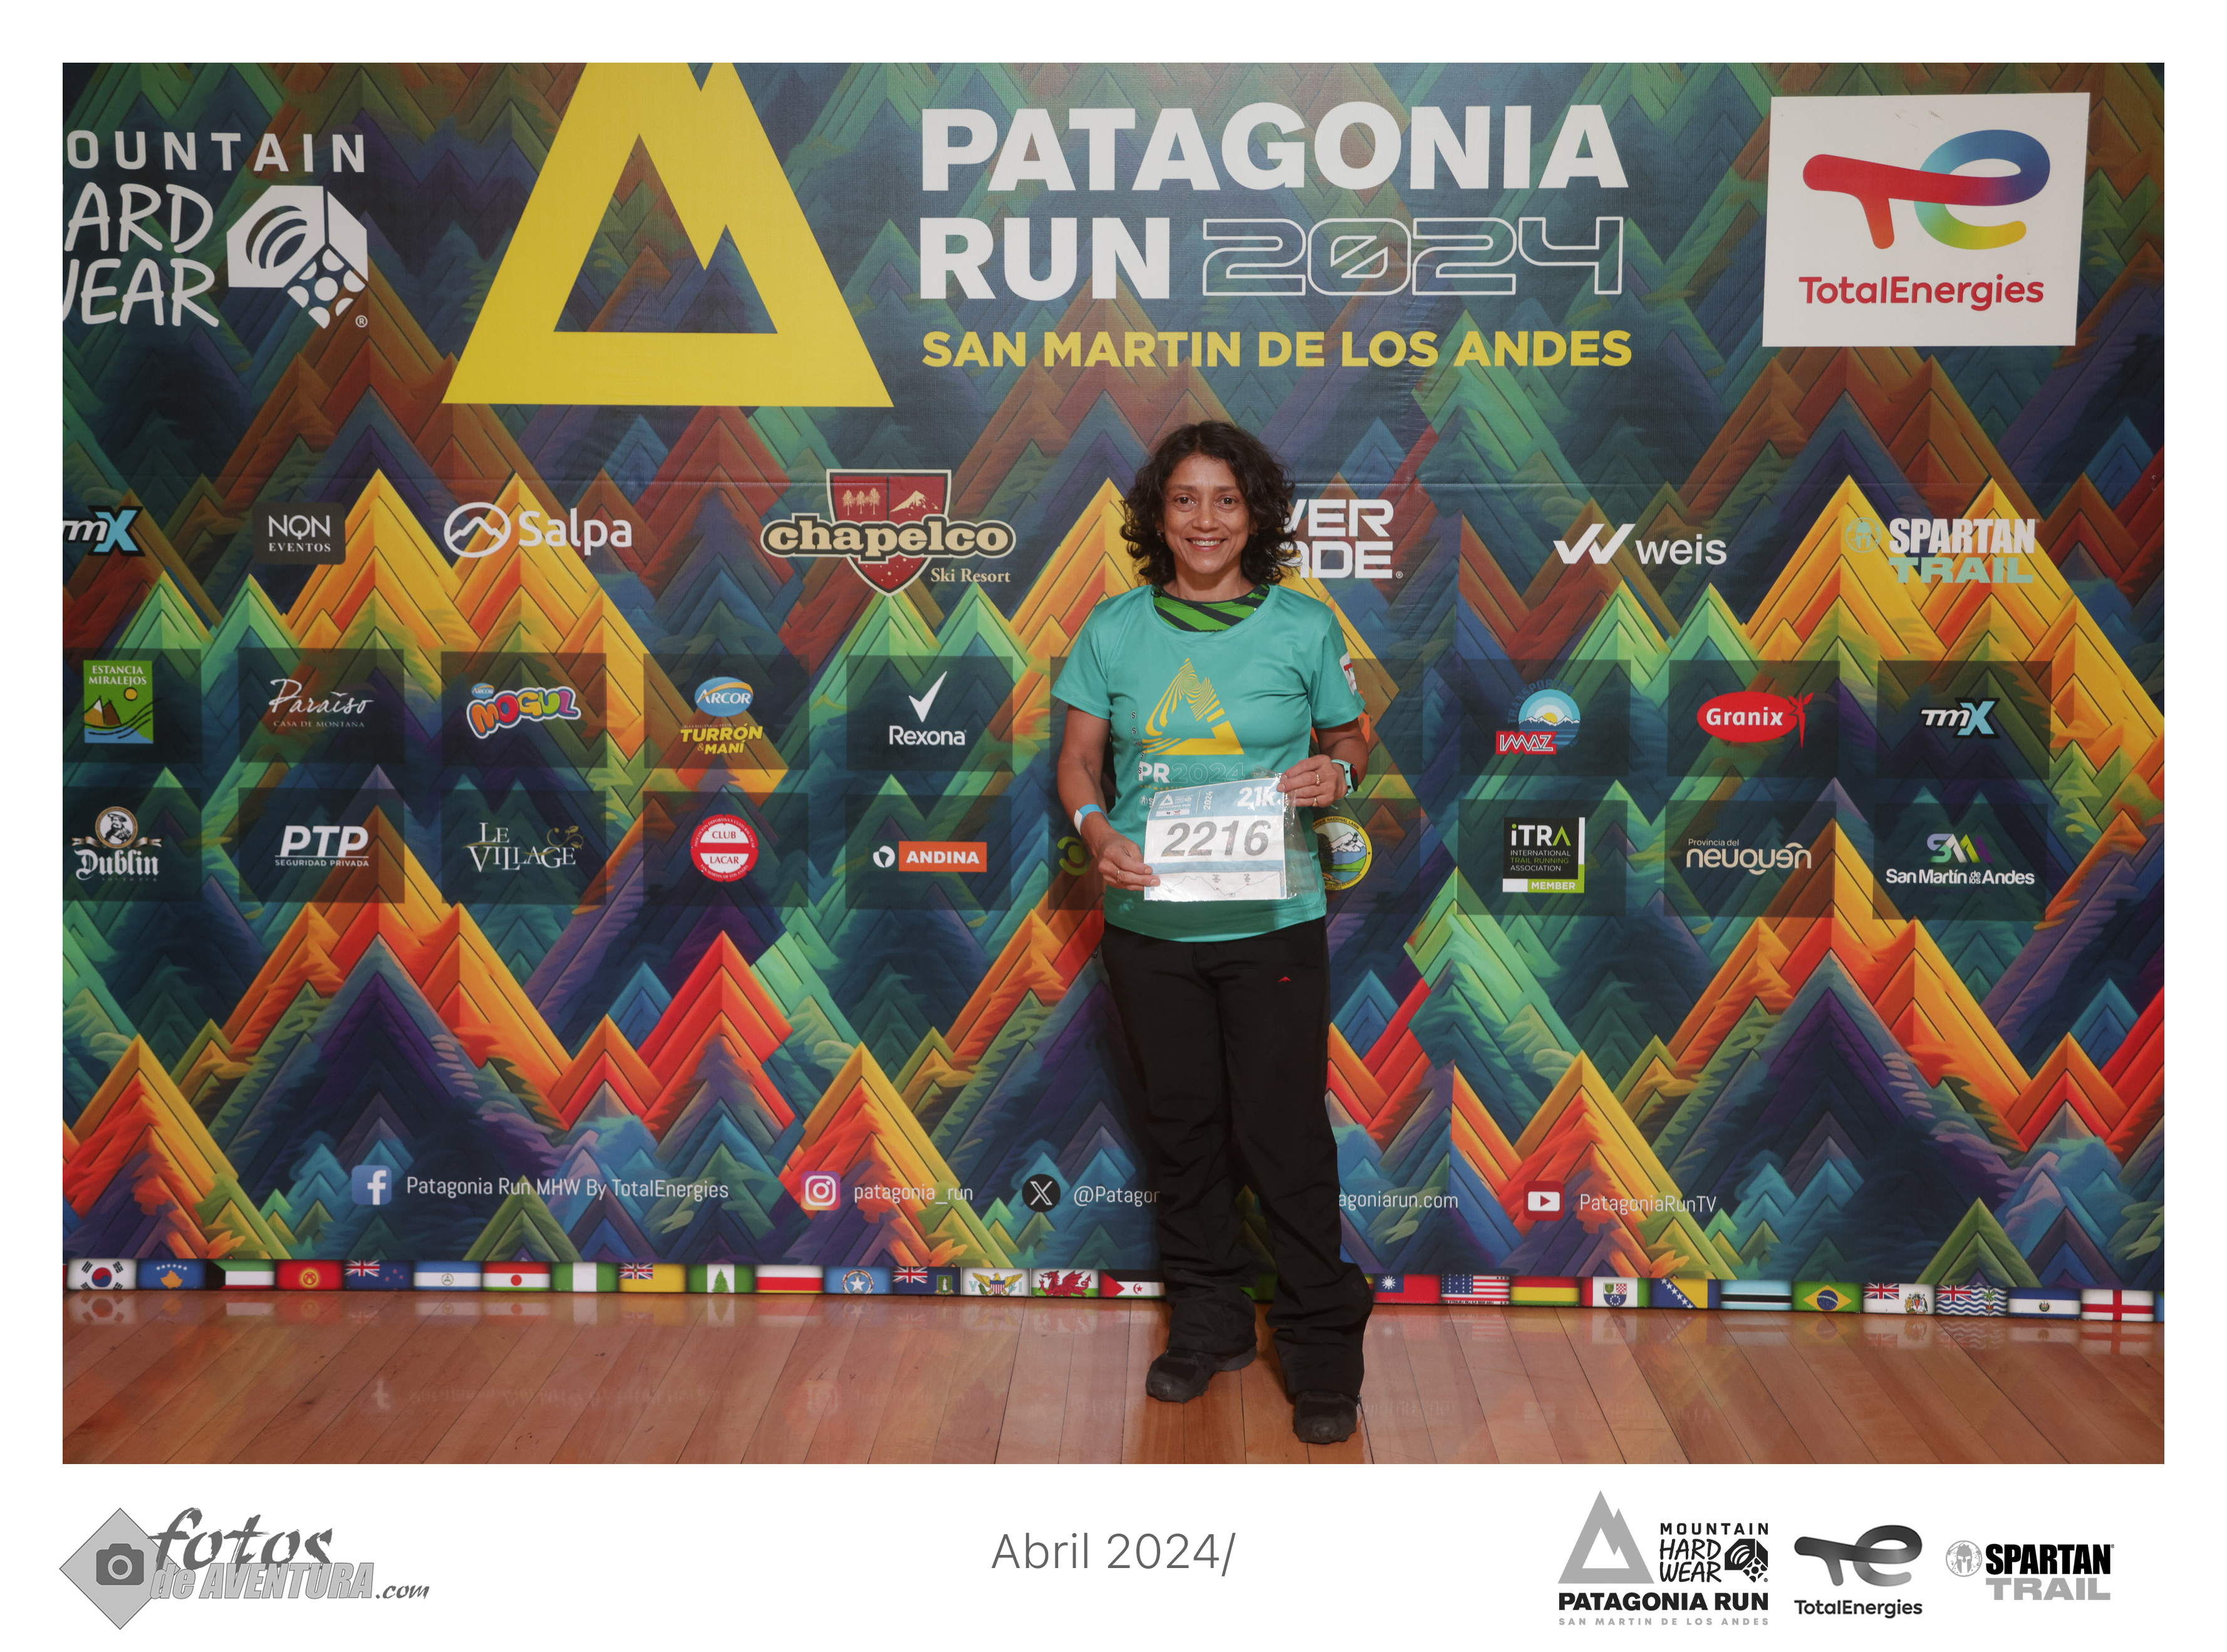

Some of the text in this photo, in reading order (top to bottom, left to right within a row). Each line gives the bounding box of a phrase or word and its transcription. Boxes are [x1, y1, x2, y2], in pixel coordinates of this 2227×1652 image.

[67, 130, 365, 173] OUNTAIN
[920, 101, 1629, 192] PATAGONIA
[63, 182, 214, 253] ARD
[919, 216, 1624, 301] RUN 2024
[1799, 274, 2044, 311] TotalEnergies
[922, 330, 1633, 368] SAN MARTIN DE LOS ANDES
[268, 515, 331, 541] NQN
[518, 507, 632, 556] Salpa
[766, 515, 1013, 559] chapelco
[1889, 517, 2035, 554] SPARTAN
[268, 542, 332, 553] EVENTOS
[1636, 533, 1727, 566] weis
[931, 568, 1011, 583] Ski Resort
[1888, 557, 2033, 584] TRAIL
[92, 665, 144, 675] ESTANCIA
[88, 675, 148, 687] MIRALEJOS
[472, 687, 494, 695] ARCOR
[696, 688, 752, 705] ARCOR
[1507, 679, 1576, 724] TRANSPORTES
[469, 688, 579, 736] MOGUL
[1706, 707, 1784, 727] Granix
[680, 723, 764, 743] TURRÓN
[889, 725, 966, 745] Rexona
[1203, 790, 1214, 811] 2024
[281, 825, 370, 858] PTP
[712, 831, 737, 839] CLUB
[1161, 819, 1272, 857] 2216
[1688, 838, 1740, 847] Provincia del
[74, 849, 159, 881] Dublin
[274, 859, 370, 867] SEGURIDAD PRIVADA
[710, 856, 739, 865] LACAR
[906, 850, 980, 865] ANDINA
[1886, 868, 1967, 885] San Martín
[1968, 876, 1981, 885] los
[1970, 870, 1981, 878] de
[1981, 870, 2035, 885] Andes
[1531, 881, 1576, 890] MEMBER
[407, 1176, 729, 1202] Patagonia Run MHW By TotalEnergies
[854, 1183, 973, 1205] patagonia_run
[1580, 1193, 1717, 1215] PatagoniaRunTV
